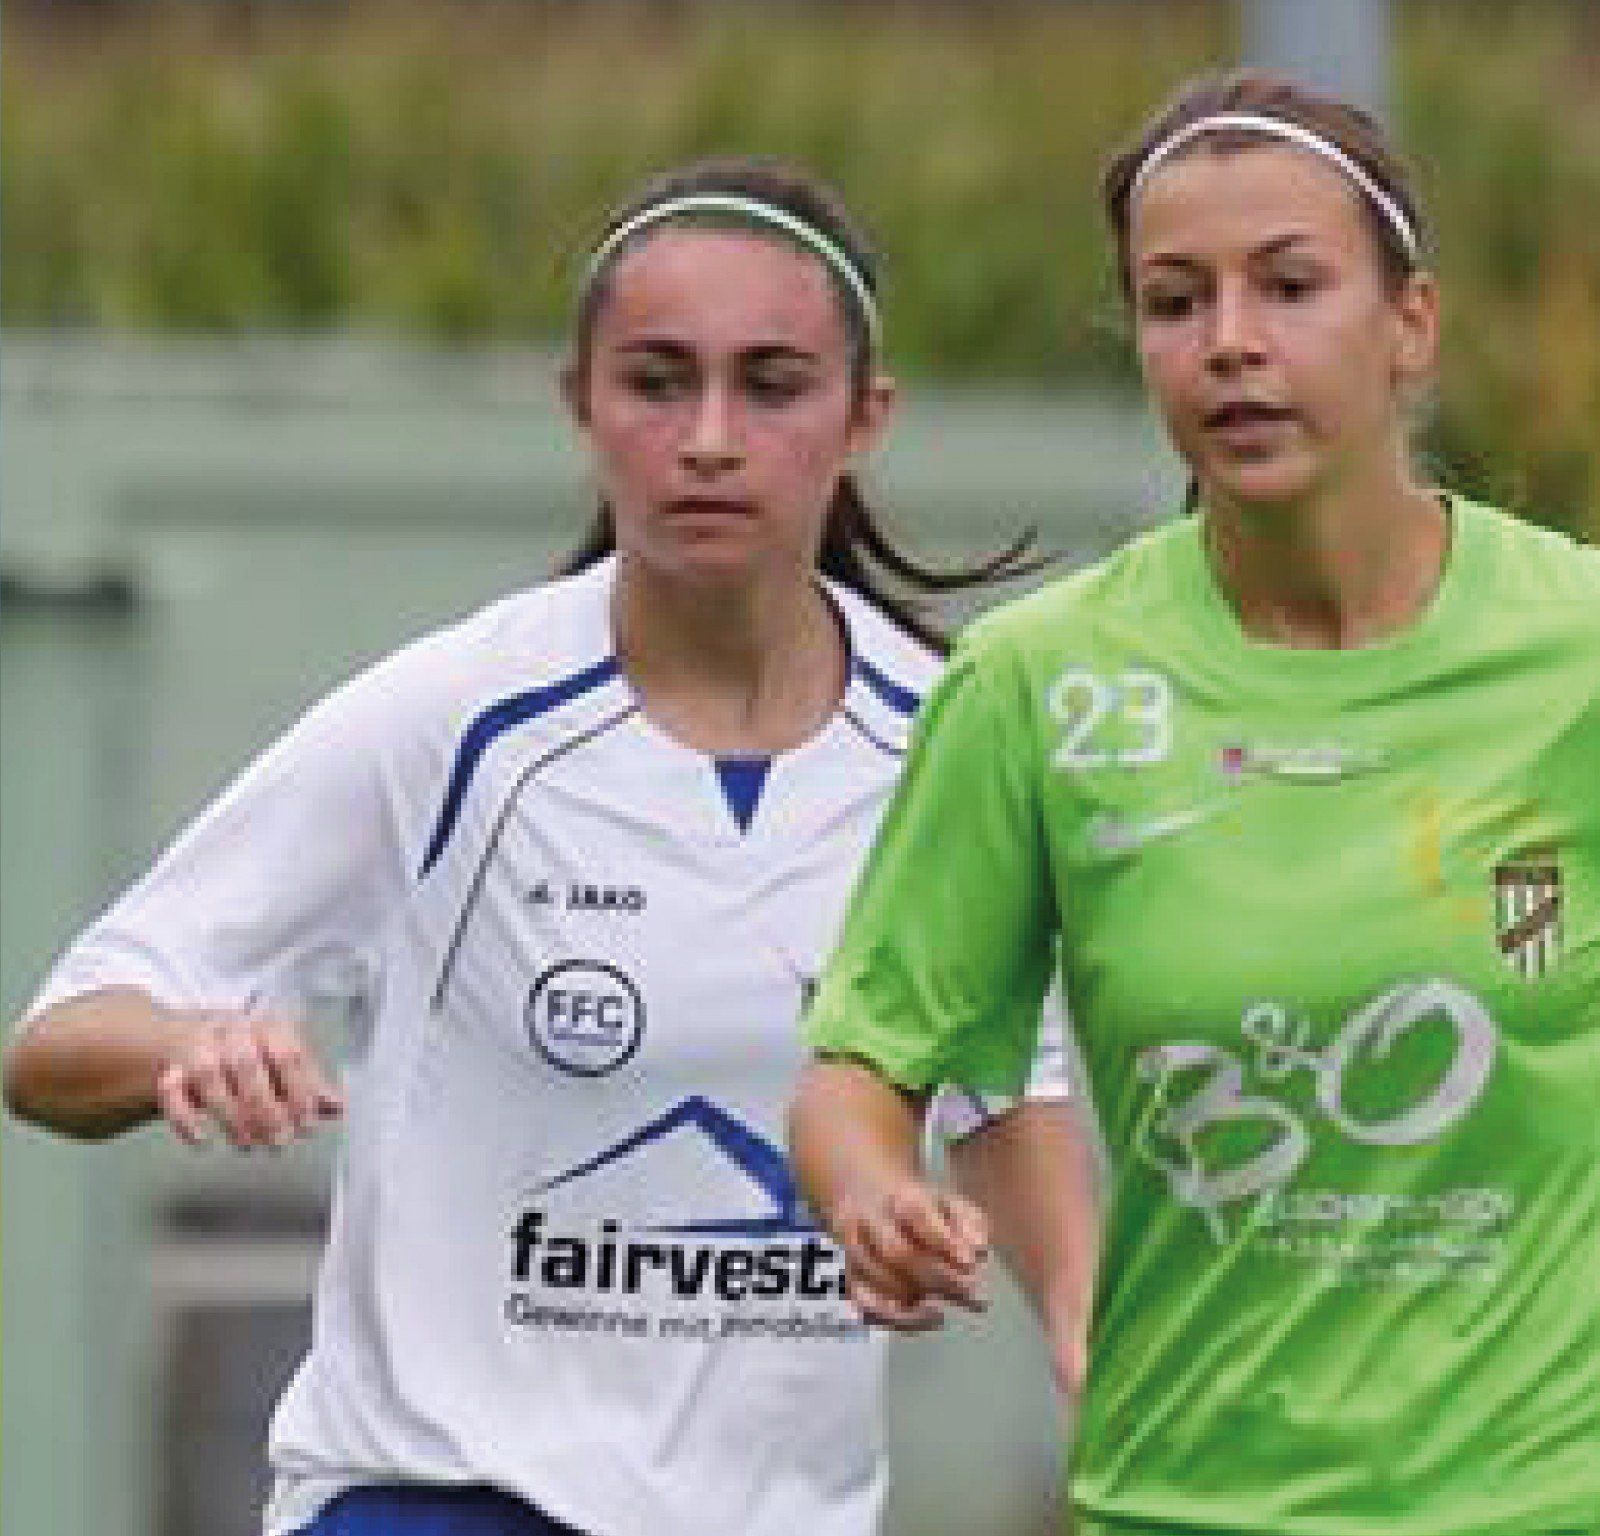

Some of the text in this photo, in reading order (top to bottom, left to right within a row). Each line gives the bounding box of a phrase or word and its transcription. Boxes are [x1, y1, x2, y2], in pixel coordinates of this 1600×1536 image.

[1047, 670, 1174, 768] 23
[547, 989, 624, 1029] FFC
[1134, 978, 1497, 1244] B&O
[511, 1213, 846, 1300] fairvest
